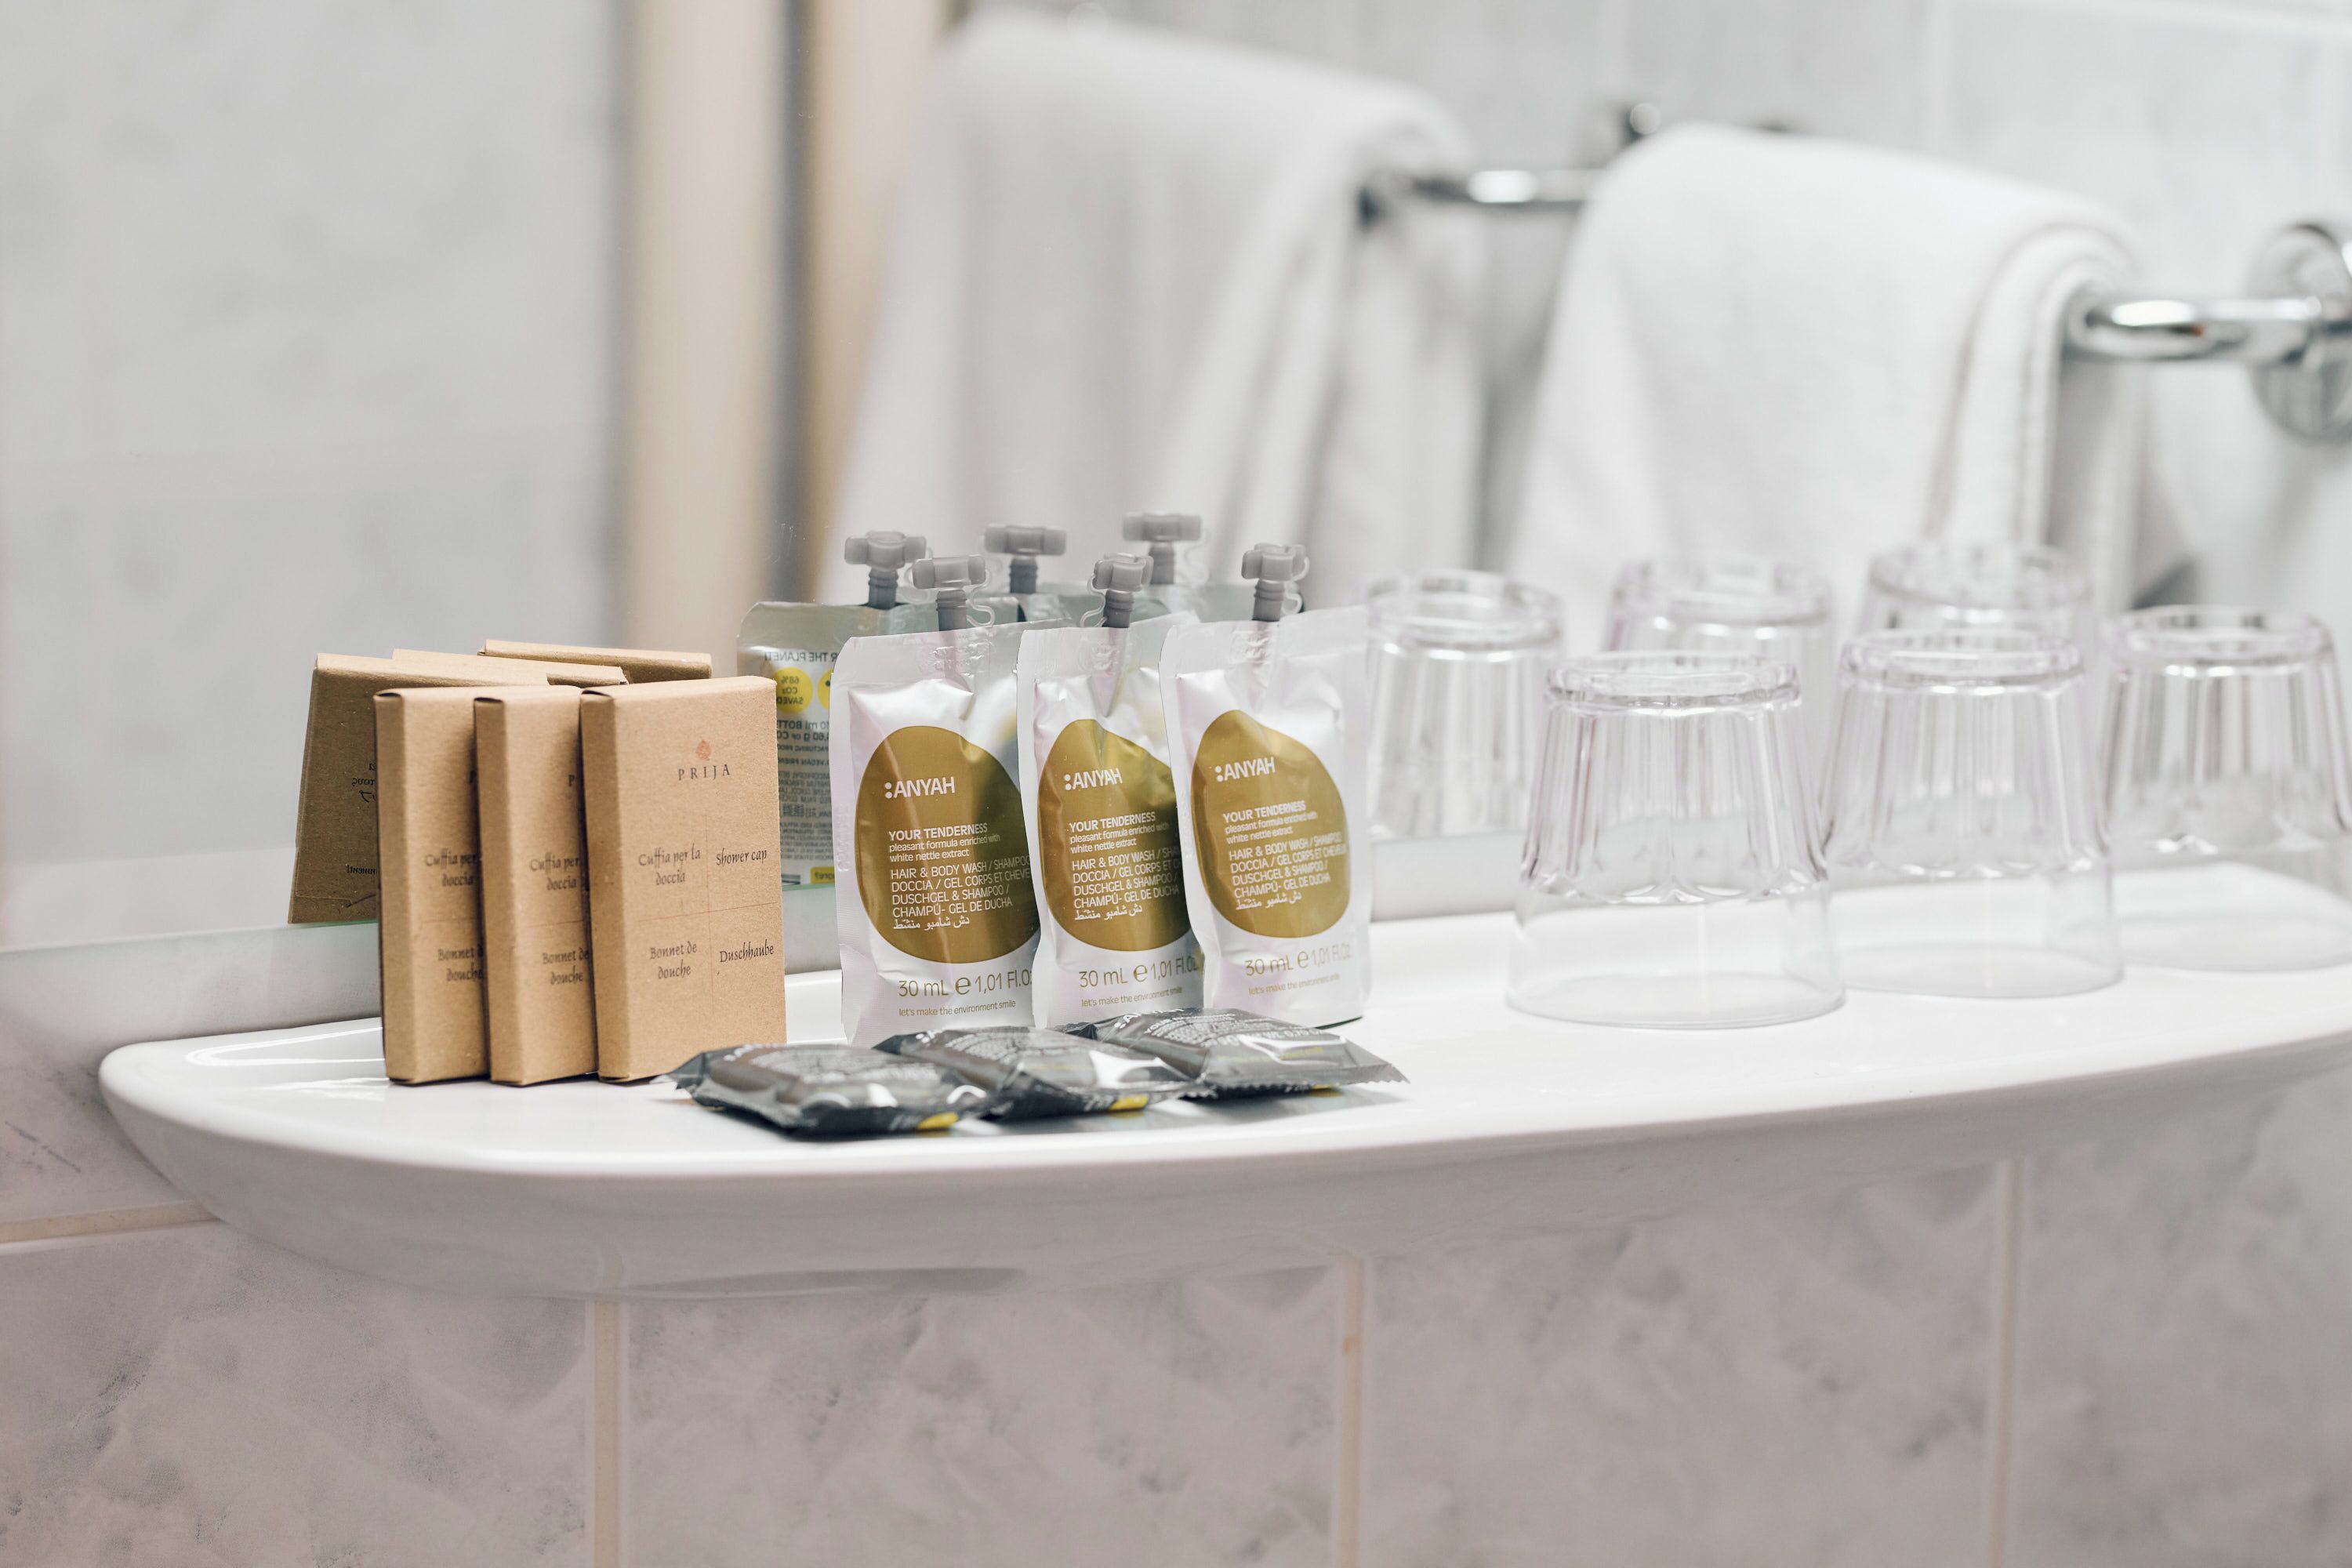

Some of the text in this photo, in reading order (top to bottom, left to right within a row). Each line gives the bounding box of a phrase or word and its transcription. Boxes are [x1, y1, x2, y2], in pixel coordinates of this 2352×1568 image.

[678, 764, 730, 781] PRIJA
[1223, 800, 1306, 823] YOUR TENDERNESS
[889, 822, 988, 841] YOUR TENDERNESS
[1069, 811, 1156, 833] YOUR TENDERNESS
[1225, 822, 1257, 835] pleasant
[1258, 818, 1283, 829] formula
[889, 833, 1000, 853] pleasant formula enriched with
[1070, 833, 1102, 844] pleasant
[1103, 828, 1128, 839] formula
[1129, 824, 1155, 835] enriched
[638, 843, 701, 868] Cuffia per la
[890, 848, 970, 862] white nettle extract
[1071, 838, 1137, 854] white nettle extract
[1229, 848, 1254, 861] HAIR
[1255, 846, 1263, 857] &
[1265, 841, 1287, 855] BODY
[1288, 838, 1308, 851] WASH
[751, 850, 767, 865] cap
[1073, 858, 1096, 870] HAIR
[1098, 857, 1106, 868] &
[1108, 853, 1130, 866] BODY
[1131, 850, 1155, 862] WASH
[1231, 858, 1269, 874] DOCCIA
[1277, 854, 1291, 866] GEL
[655, 869, 685, 885] doccia
[891, 868, 916, 880] HAIR
[920, 867, 928, 877] &
[931, 864, 960, 877] BODY
[962, 862, 987, 873] WASH
[1073, 869, 1111, 884] DOCCIA
[1119, 866, 1134, 877] GEL
[1134, 861, 1161, 875] CORPS
[1232, 869, 1283, 887] DUSCHGEL
[1284, 866, 1291, 878] &
[1292, 860, 1323, 877] SHAMPOO
[546, 877, 577, 891] doccia
[891, 880, 933, 892] DOCCIA
[944, 877, 963, 889] GEL
[965, 873, 993, 886] CORPS
[994, 872, 1004, 882] ET
[1074, 881, 1124, 896] DUSCHGEL
[1126, 879, 1132, 890] &
[1134, 873, 1173, 888] SHAMPOO
[1283, 878, 1298, 891] GEL
[1298, 876, 1309, 888] DE
[1308, 872, 1330, 886] DUCHA
[892, 891, 949, 906] DUSCHGEL
[952, 890, 960, 901] &
[962, 884, 1004, 899] SHAMPOO
[1124, 890, 1140, 903] GEL
[1142, 887, 1152, 900] DE
[949, 903, 967, 914] GEL
[970, 902, 982, 912] DE
[985, 897, 1013, 910] DUCHA
[543, 949, 576, 964] Bonnet
[650, 940, 697, 960] Bonnet de
[720, 939, 774, 962] Duschhaube
[658, 960, 691, 978] douche
[1245, 959, 1265, 976] 30
[1269, 954, 1294, 973] mL
[1312, 949, 1330, 967] 1,01
[550, 965, 583, 985] douche
[1079, 970, 1098, 988] 30
[1104, 967, 1127, 985] mL
[1151, 960, 1171, 980] 1,01
[898, 980, 919, 997] 30
[924, 979, 949, 996] mL
[975, 973, 1002, 994] 1,01
[1099, 995, 1119, 1006] make
[1121, 993, 1133, 1003] the
[1134, 988, 1169, 1002] environment
[916, 1006, 938, 1016] make
[939, 1004, 953, 1015] the
[954, 1002, 998, 1014] environment
[999, 1000, 1016, 1011] smile
